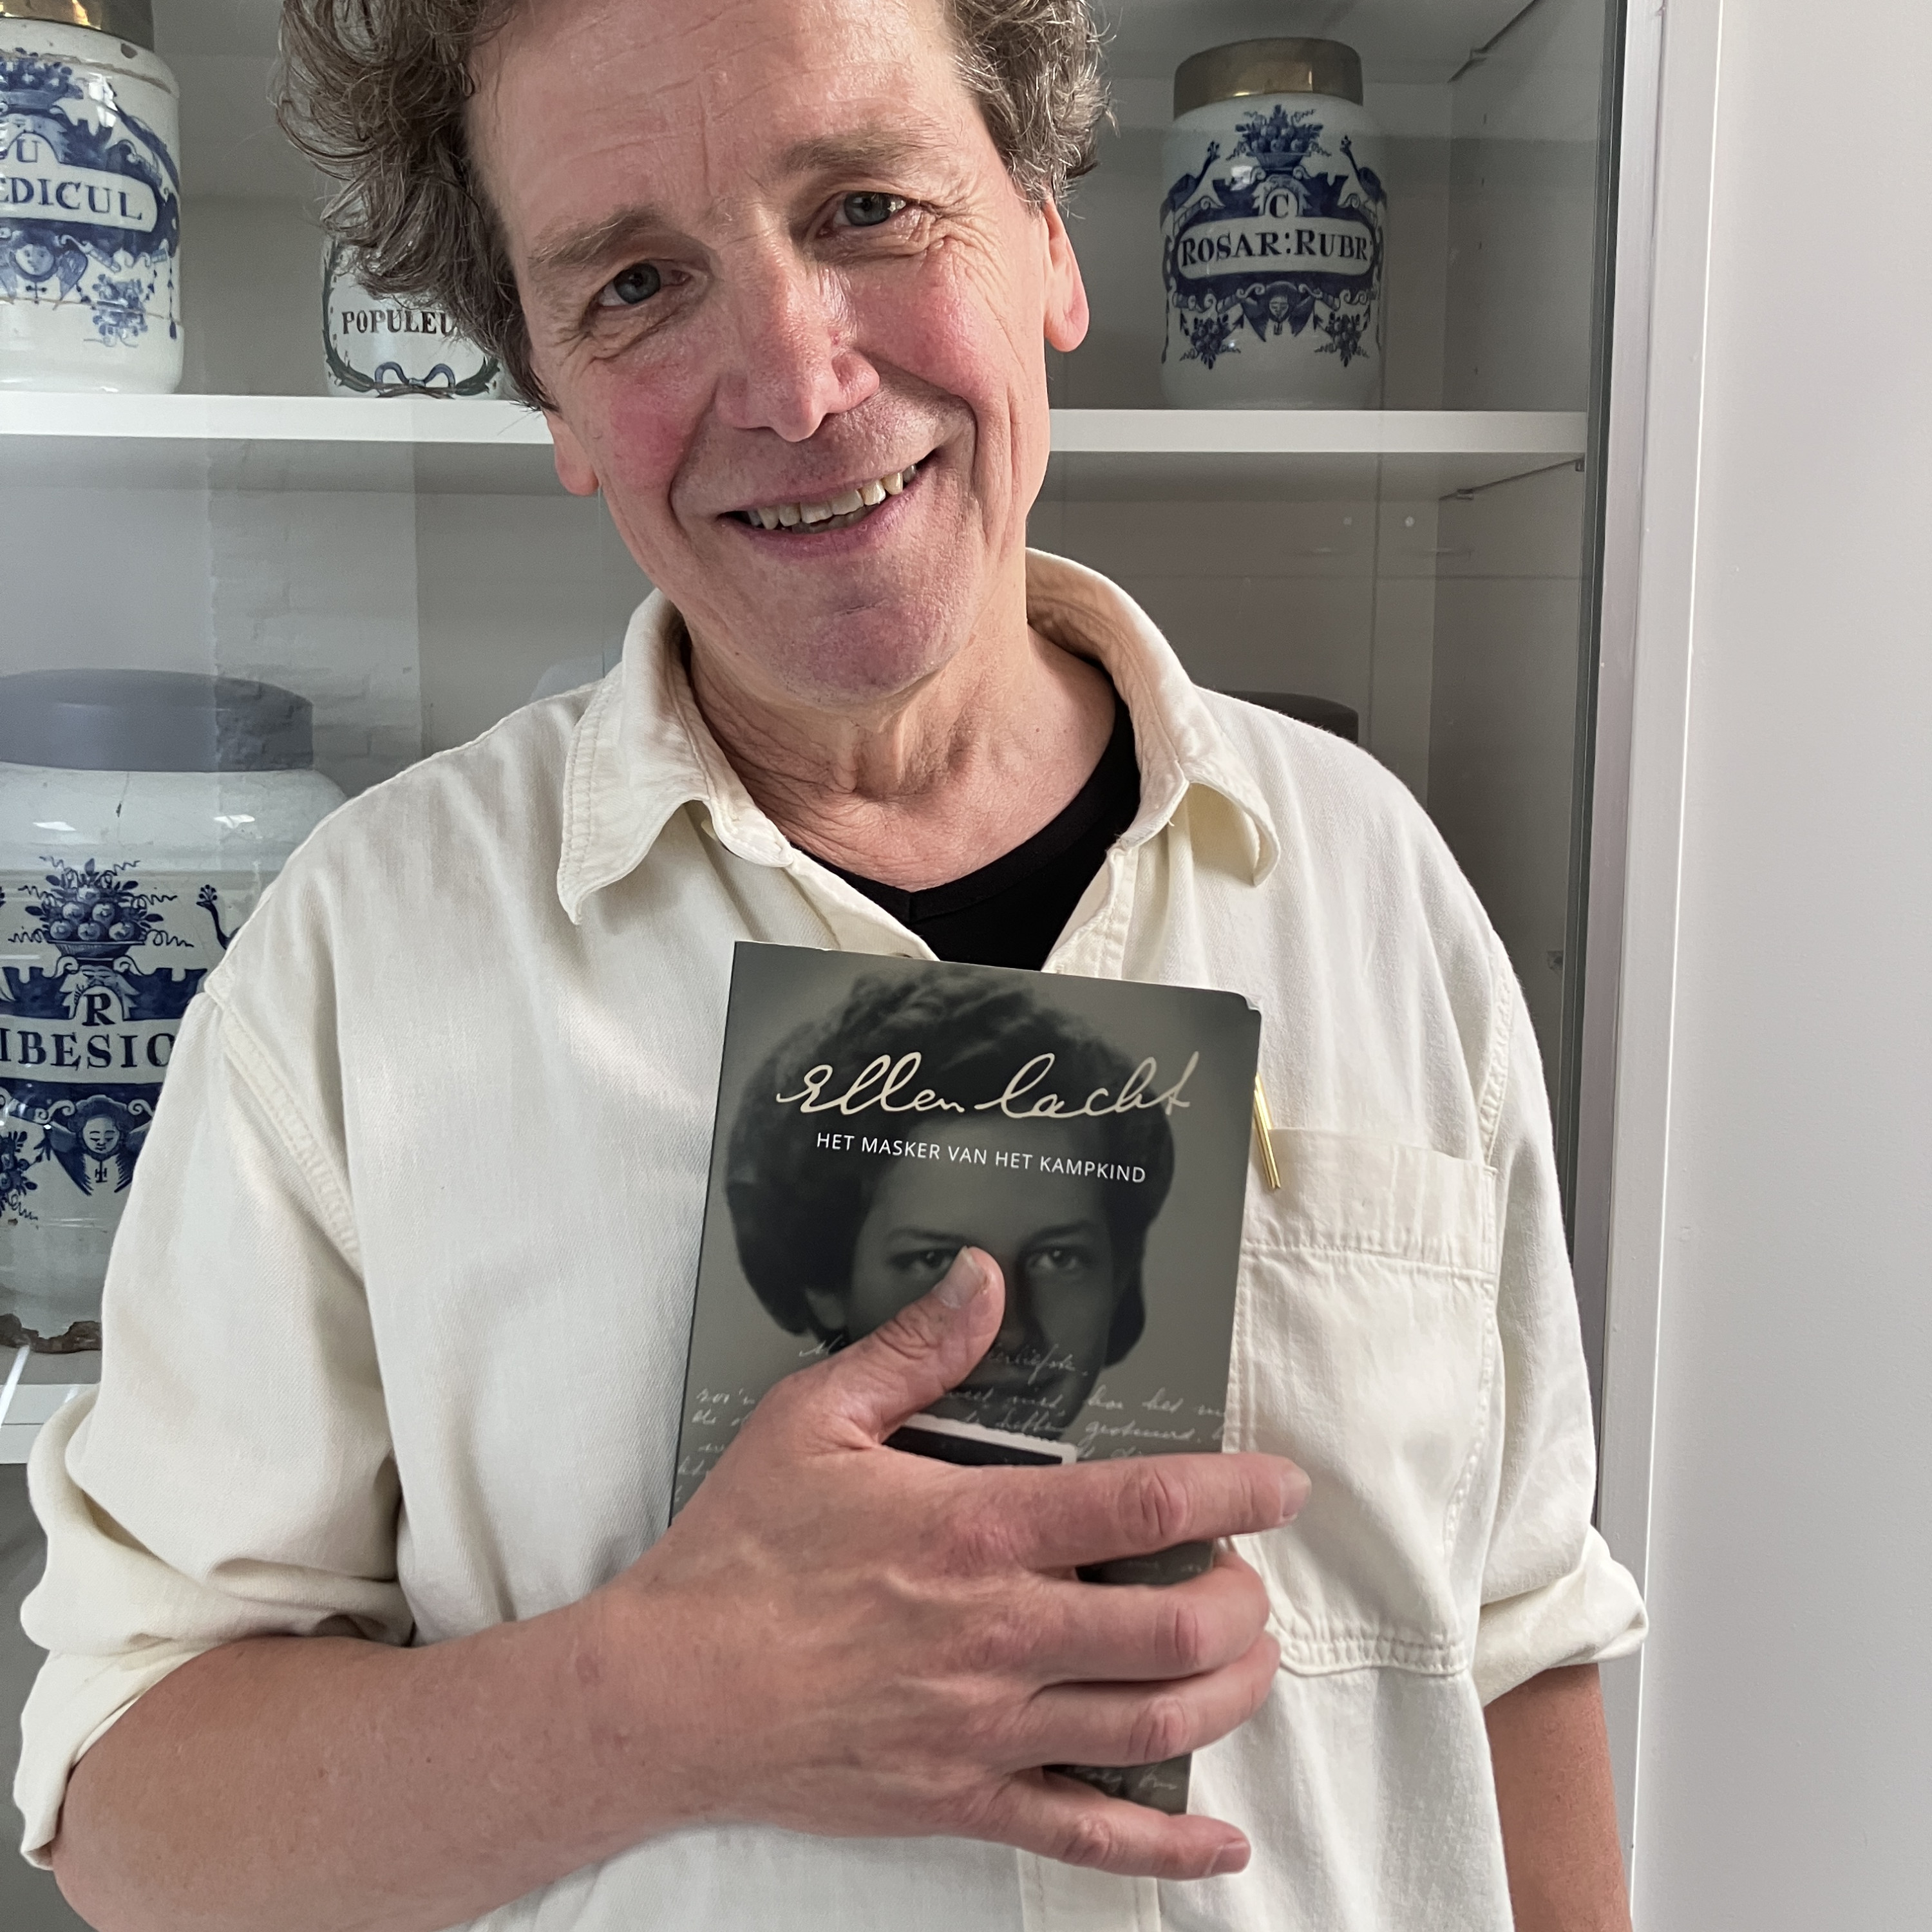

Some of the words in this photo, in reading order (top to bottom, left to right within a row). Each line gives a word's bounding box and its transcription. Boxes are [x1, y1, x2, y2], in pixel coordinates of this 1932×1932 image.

[1269, 193, 1290, 219] C
[82, 992, 117, 1027] R
[776, 1052, 965, 1115] Ellen
[974, 1050, 1199, 1119] lacht
[816, 1132, 855, 1151] HET
[861, 1137, 940, 1160] MASKER
[947, 1145, 987, 1165] VAN
[995, 1151, 1034, 1170] HET
[1039, 1155, 1146, 1183] KAMPKIND
